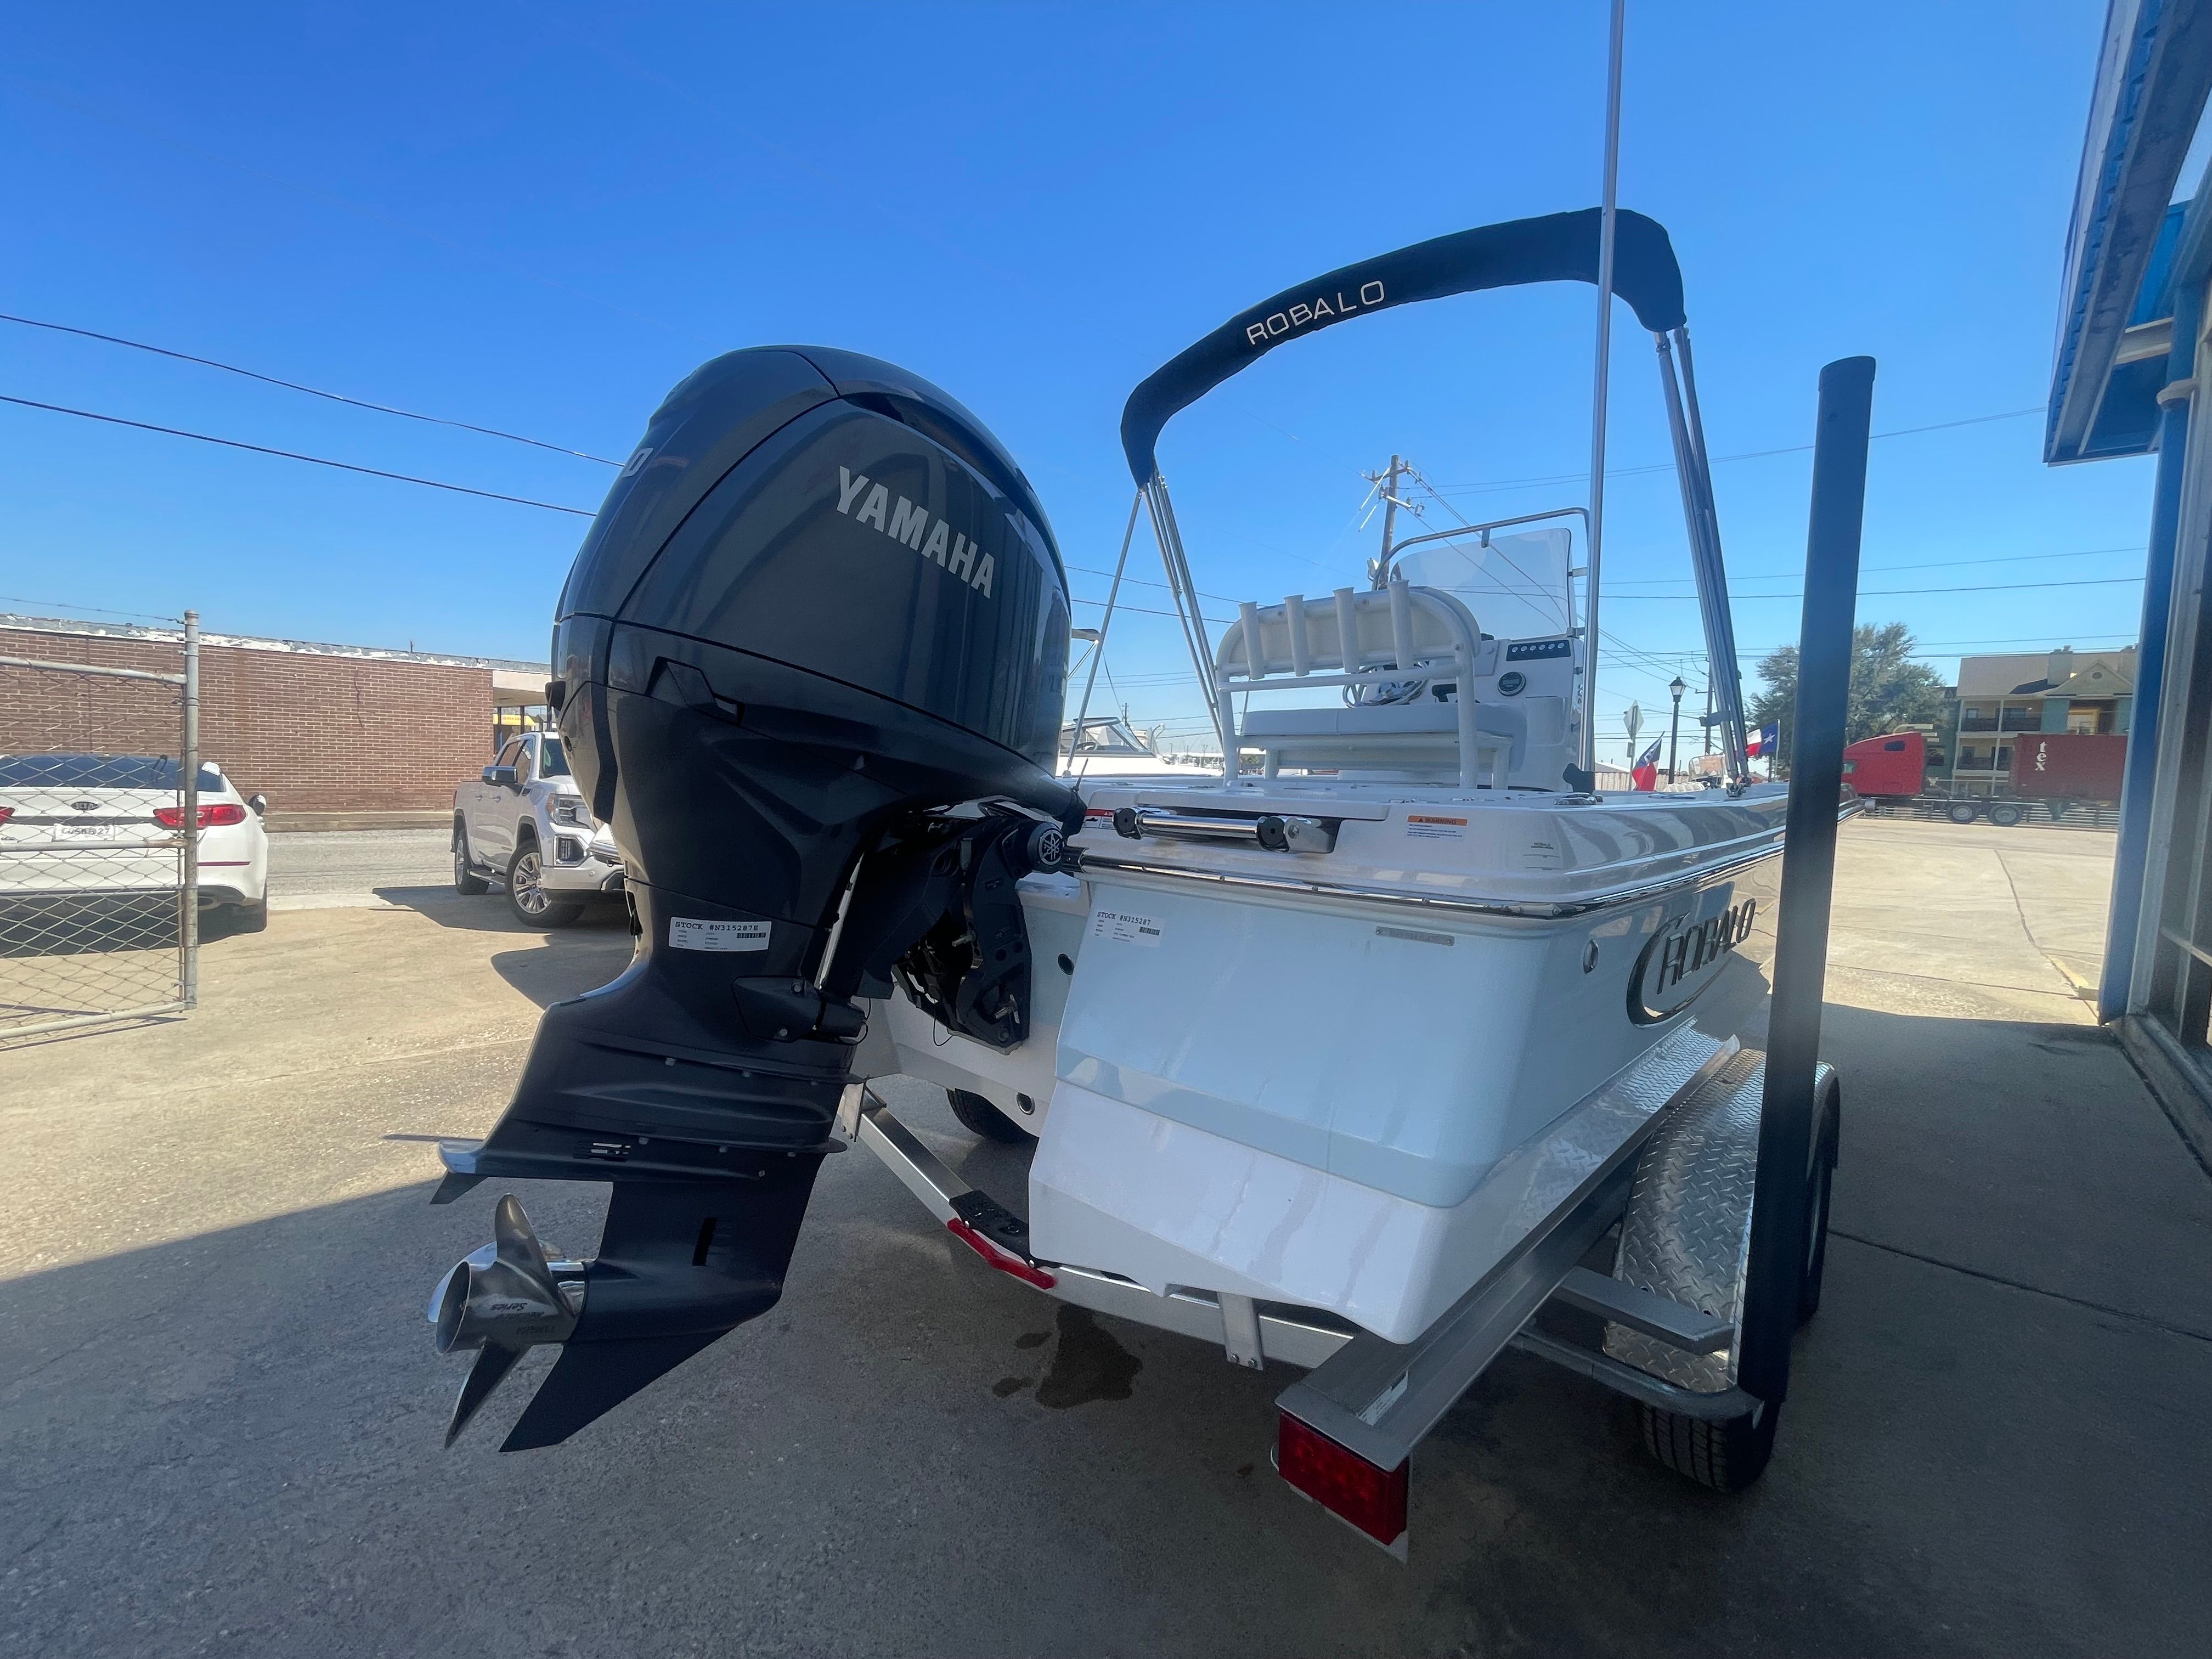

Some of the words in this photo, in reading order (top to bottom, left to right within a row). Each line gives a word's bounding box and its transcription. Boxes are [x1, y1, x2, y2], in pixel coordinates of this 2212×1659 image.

[1246, 280, 1385, 345] ROBALO
[837, 465, 995, 599] YAMAHA
[675, 921, 703, 929] STOCK
[1097, 911, 1116, 919] STOCK
[1120, 915, 1151, 926] #N315287
[1656, 898, 1757, 995] ROBALO
